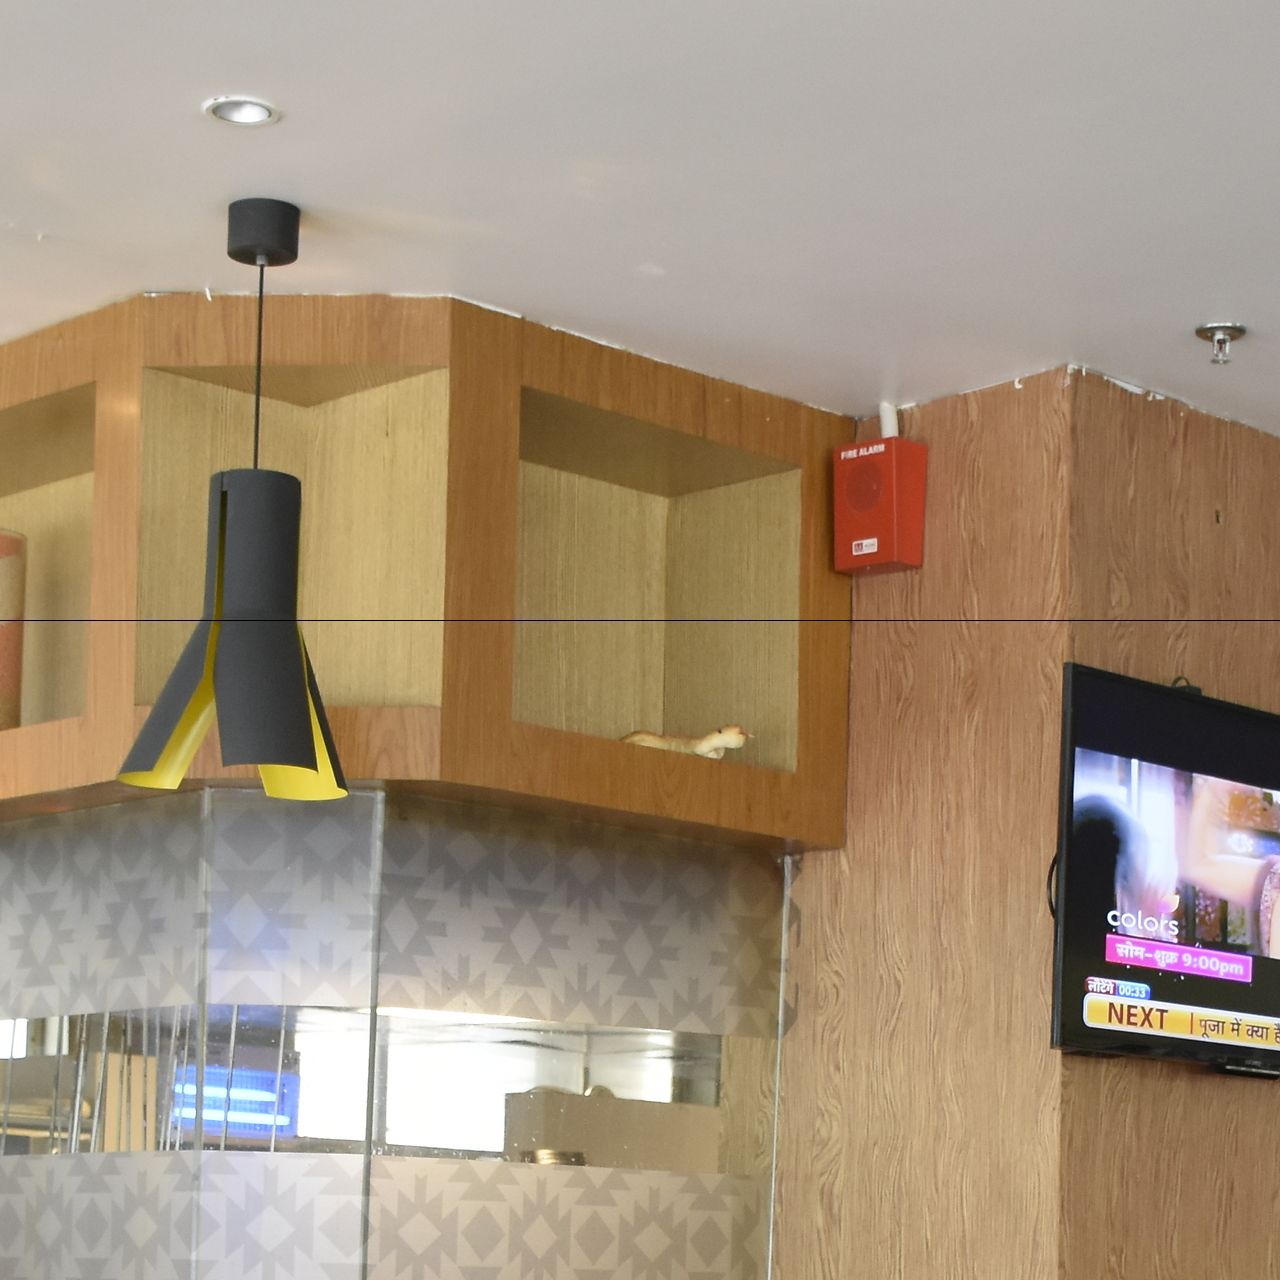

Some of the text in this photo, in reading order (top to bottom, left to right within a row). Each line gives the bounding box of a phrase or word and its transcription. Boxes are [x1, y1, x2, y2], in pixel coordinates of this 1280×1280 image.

[840, 443, 885, 460] FIRE ALARM
[1106, 910, 1180, 936] colors
[1118, 984, 1147, 998] 00:33
[1108, 1002, 1169, 1030] NEXT
[1199, 1018, 1226, 1039] पूजा
[1231, 1017, 1243, 1038] में
[1246, 1023, 1270, 1041] क्या
